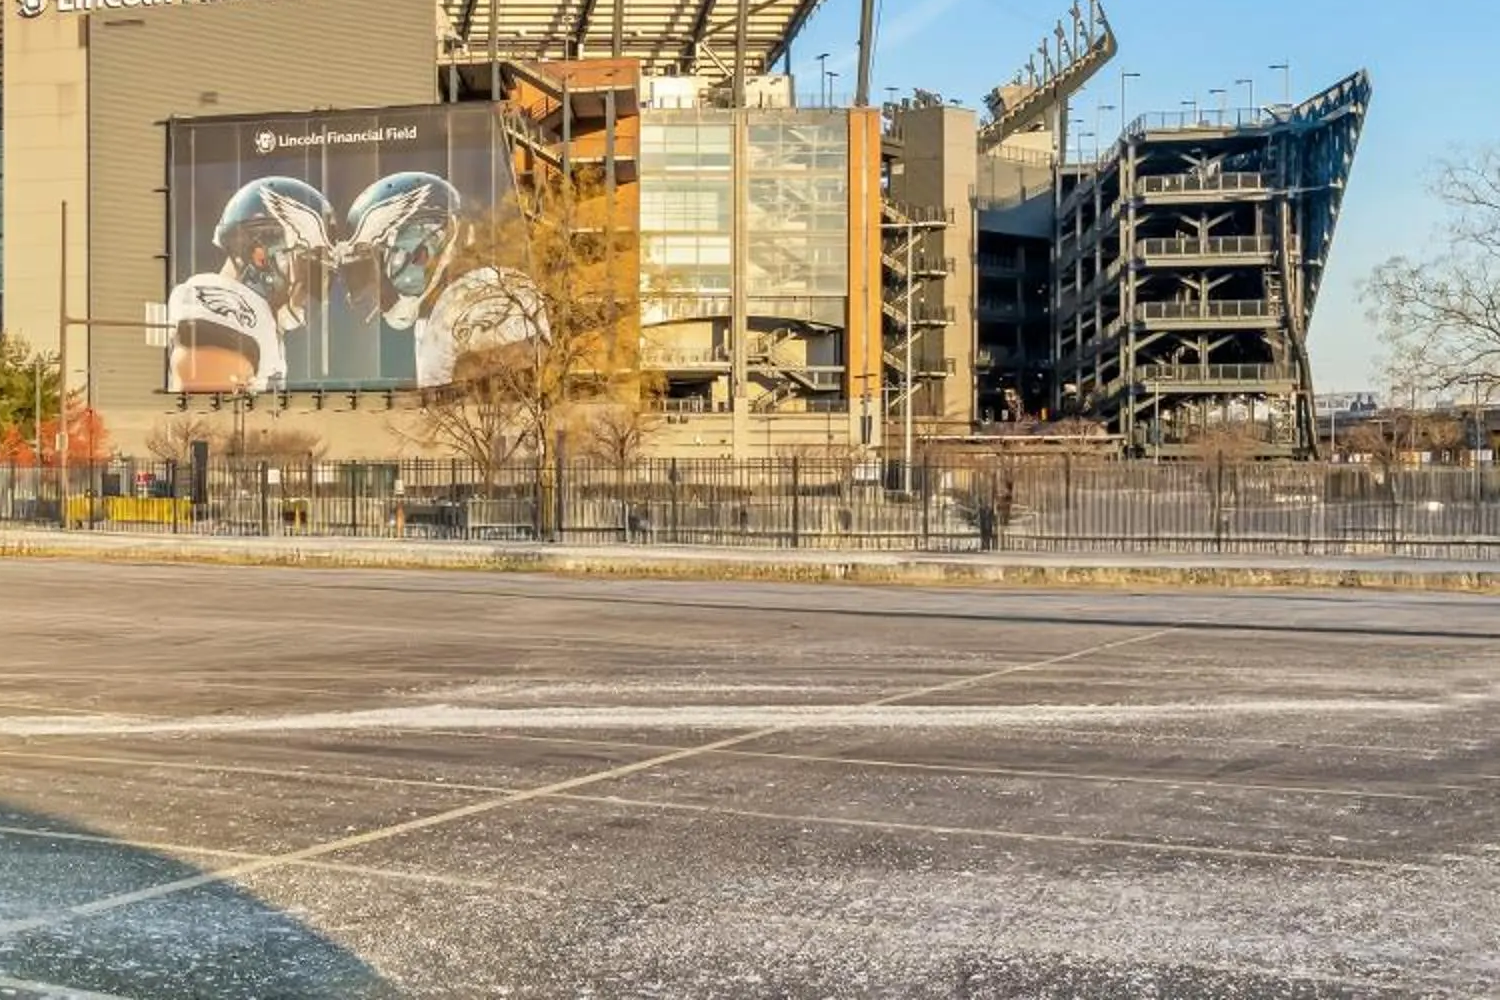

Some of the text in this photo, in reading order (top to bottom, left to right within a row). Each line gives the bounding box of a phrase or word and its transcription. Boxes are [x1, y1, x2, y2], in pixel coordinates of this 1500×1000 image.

[278, 125, 418, 148] Lincoln Financial Field
